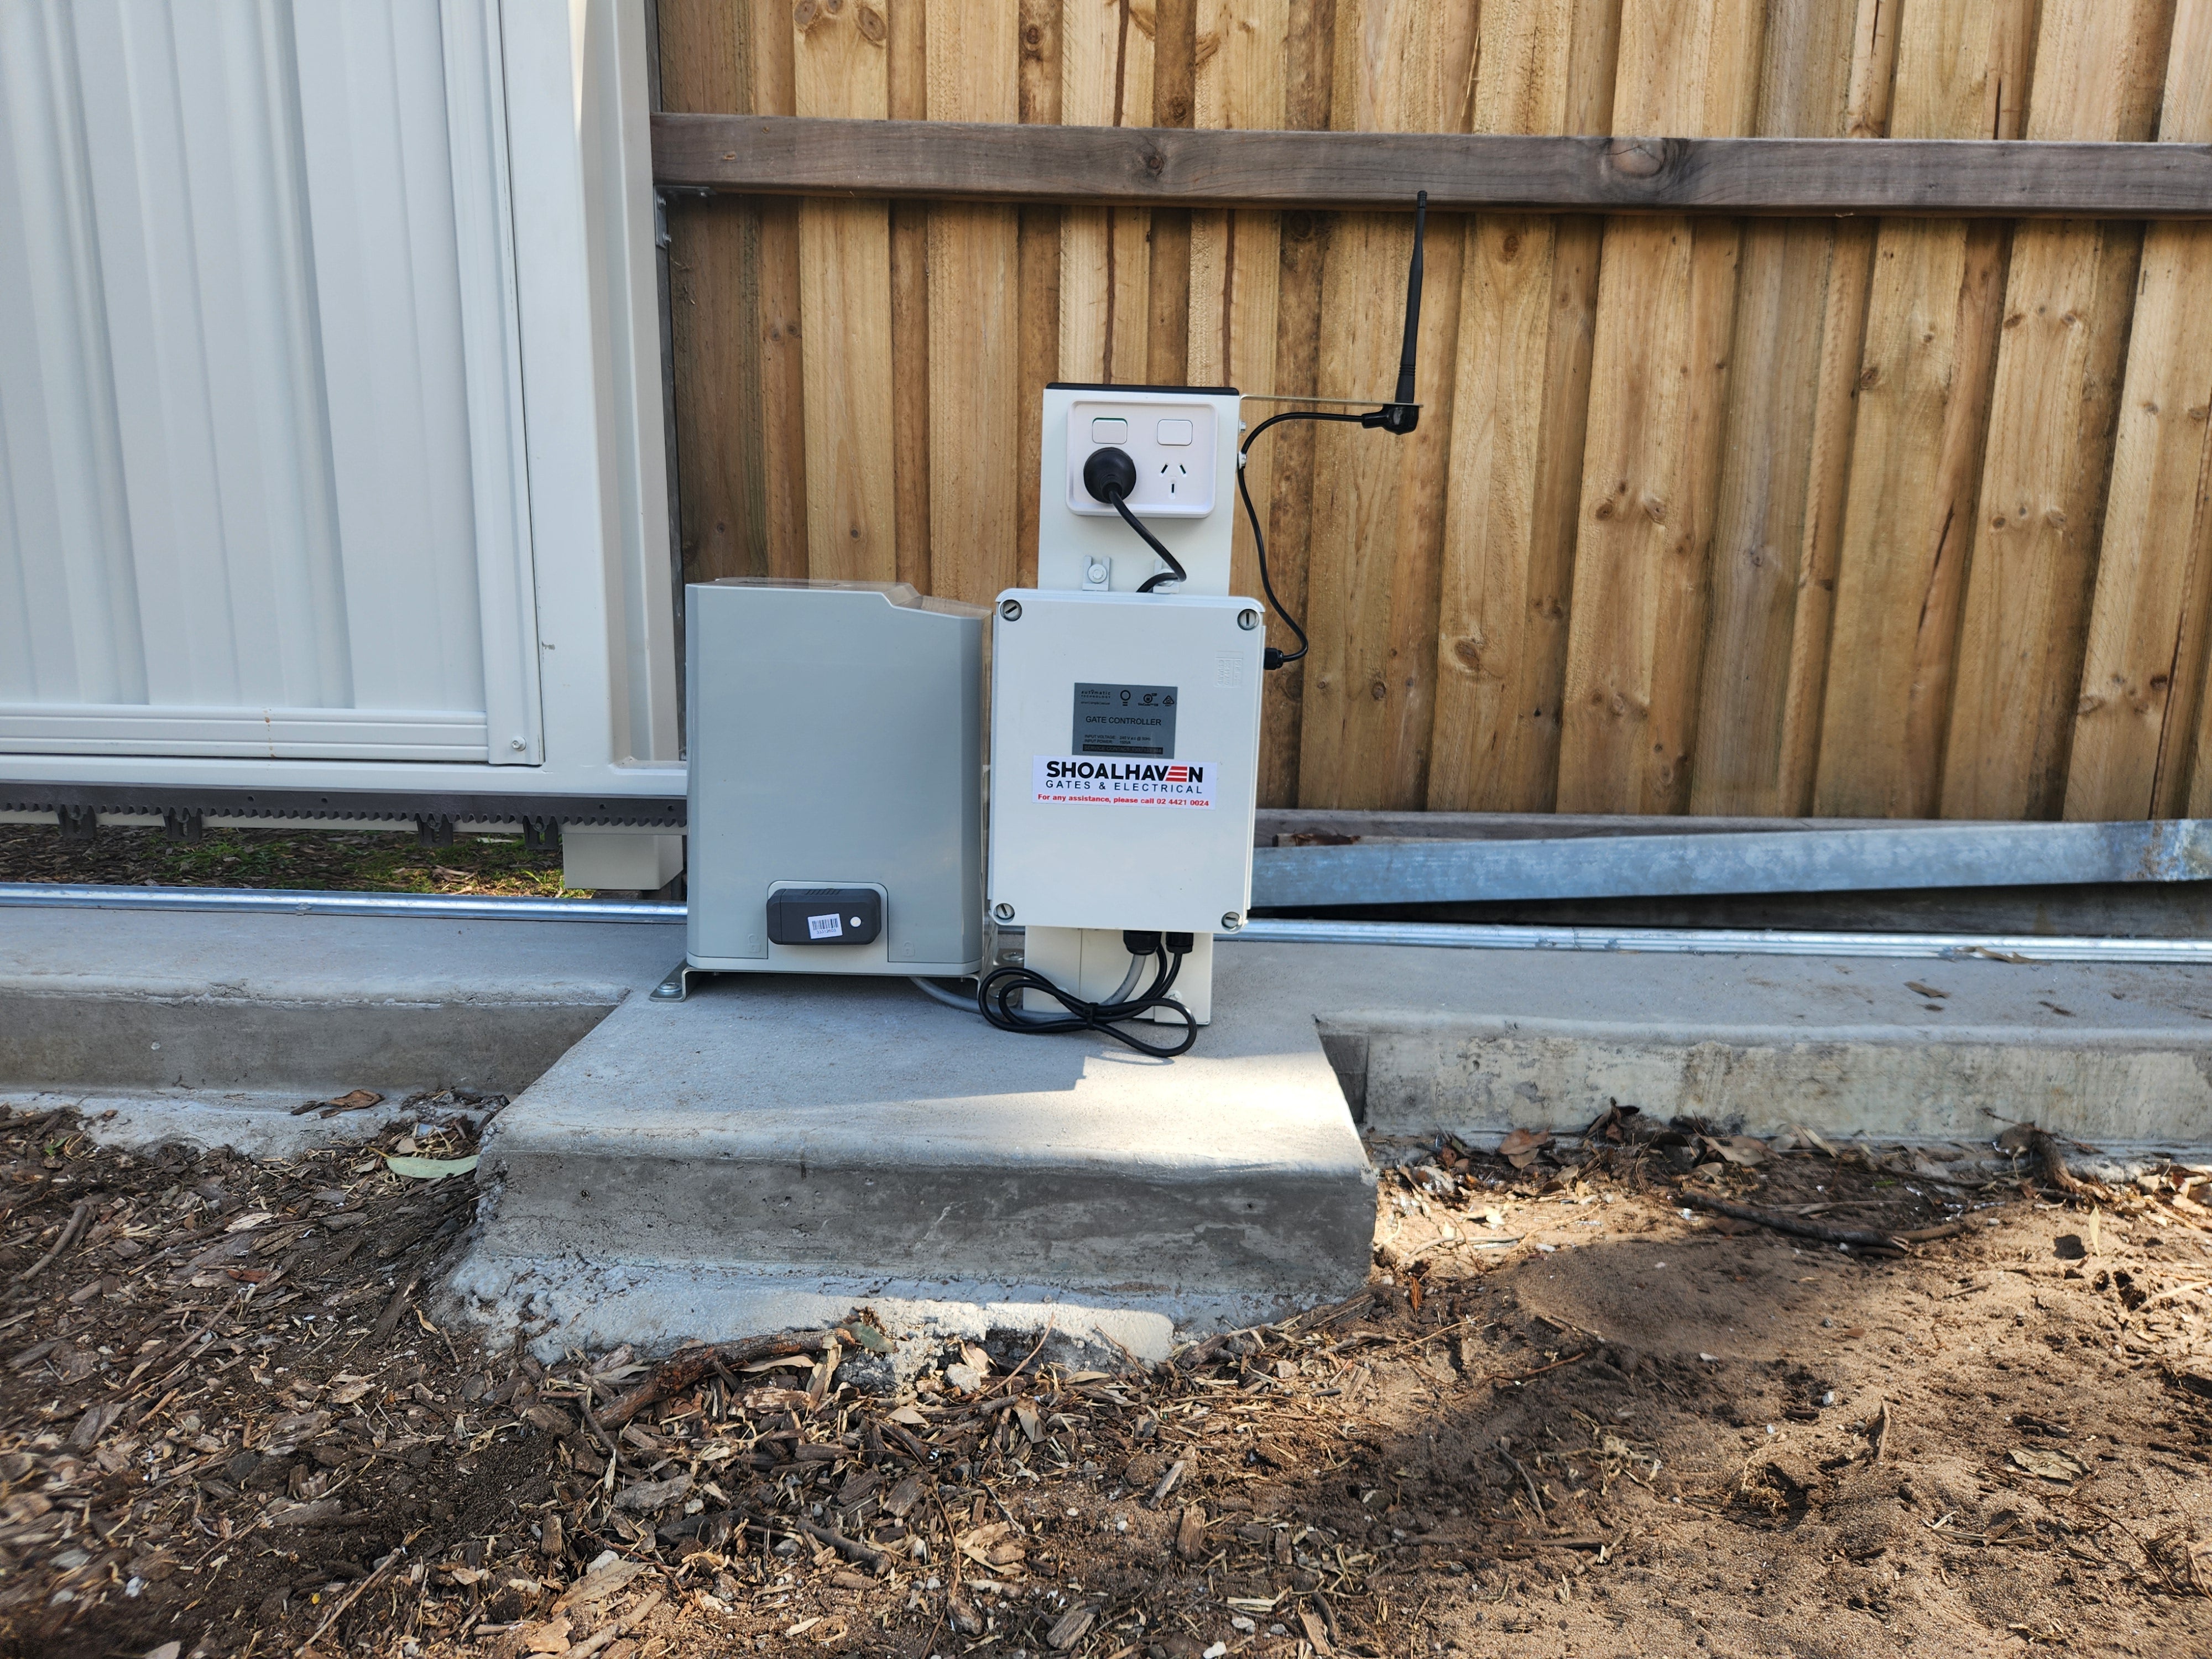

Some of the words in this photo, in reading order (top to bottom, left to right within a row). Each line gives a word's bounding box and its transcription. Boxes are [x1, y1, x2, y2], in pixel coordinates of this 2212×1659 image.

[1108, 717, 1162, 726] CONTROLLER
[1046, 761, 1203, 783] SHOALHAVEN
[1046, 780, 1091, 789] GATES
[1098, 781, 1106, 790] &
[1114, 782, 1202, 794] ELECTRICAL
[1068, 795, 1111, 804] assistance,
